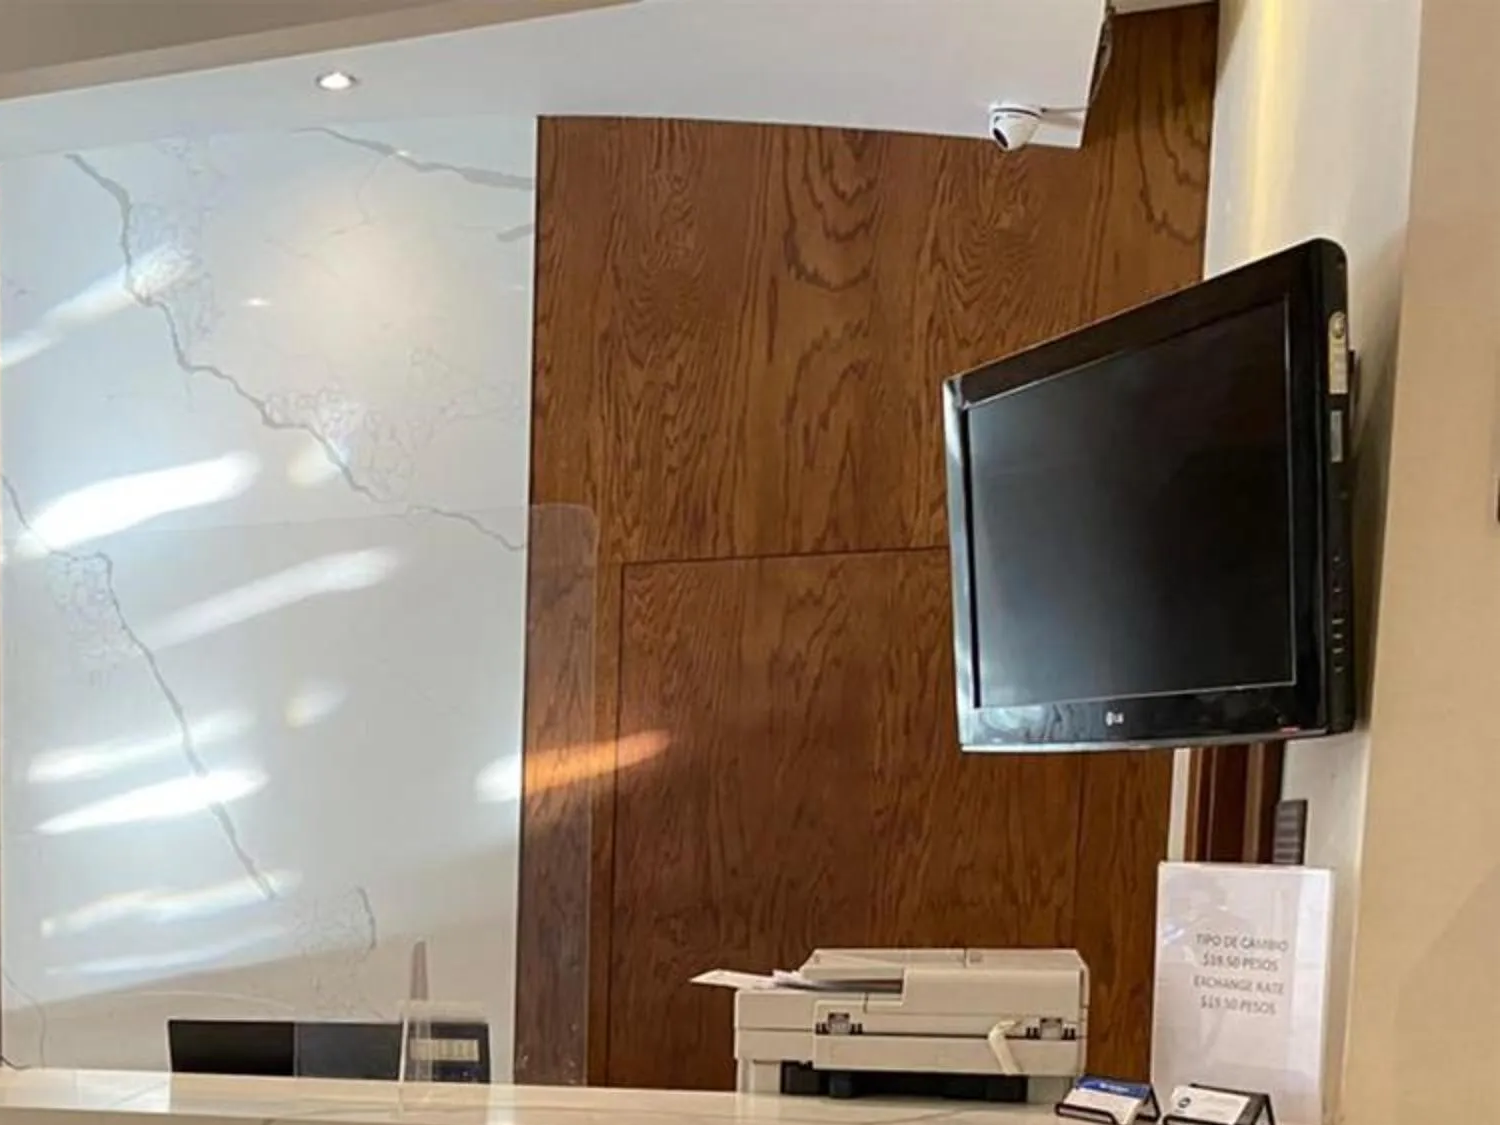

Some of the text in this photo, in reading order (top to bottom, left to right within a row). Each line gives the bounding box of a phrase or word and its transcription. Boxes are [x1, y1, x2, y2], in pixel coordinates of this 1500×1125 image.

[1196, 933, 1288, 952] TIPO DE CAMBIO
[1242, 957, 1279, 972] PESOS
[1193, 975, 1284, 997] EXCHANGE RATE
[1240, 999, 1277, 1016] PESOS
